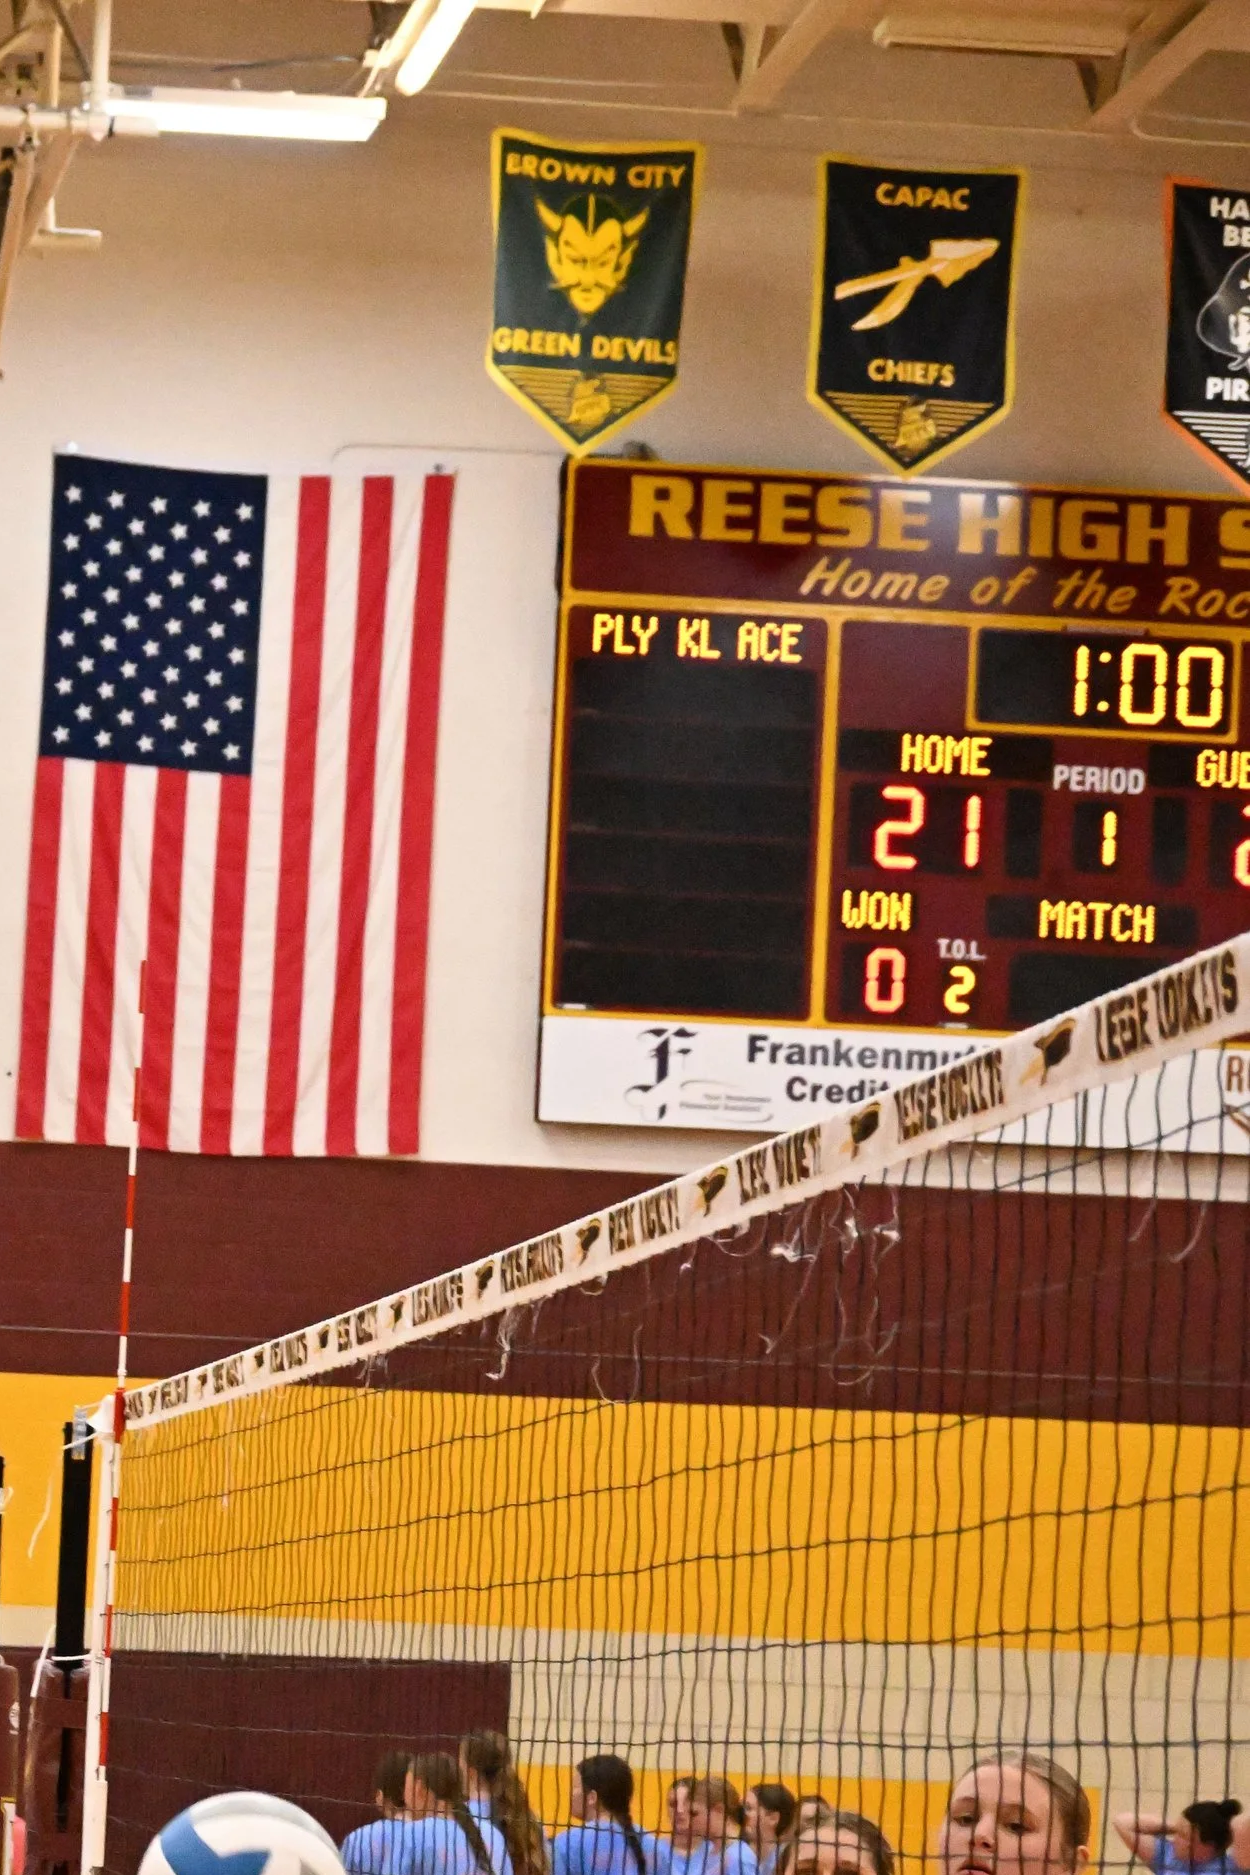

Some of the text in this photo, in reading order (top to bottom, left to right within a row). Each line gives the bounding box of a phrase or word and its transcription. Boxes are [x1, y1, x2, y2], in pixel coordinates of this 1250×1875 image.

[506, 153, 686, 189] BROWN CITY
[875, 182, 970, 211] CAPAC
[493, 327, 678, 365] GREEN DEVILS
[867, 358, 955, 388] CHIEFS
[627, 474, 930, 553] REESE
[957, 492, 1189, 567] HIGH
[800, 556, 1250, 621] Home of the Roc
[592, 613, 803, 665] PLY KL ACE
[1072, 642, 1225, 728] 1:00
[900, 733, 993, 777] HOME
[1053, 765, 1146, 796] PERIOD
[874, 785, 981, 870] 21
[1102, 810, 1117, 867] 1
[842, 890, 912, 931] WON
[1038, 900, 1155, 943] MATCH
[865, 948, 906, 1013] 0
[944, 965, 975, 1014] 2
[747, 1034, 986, 1071] Frankenm
